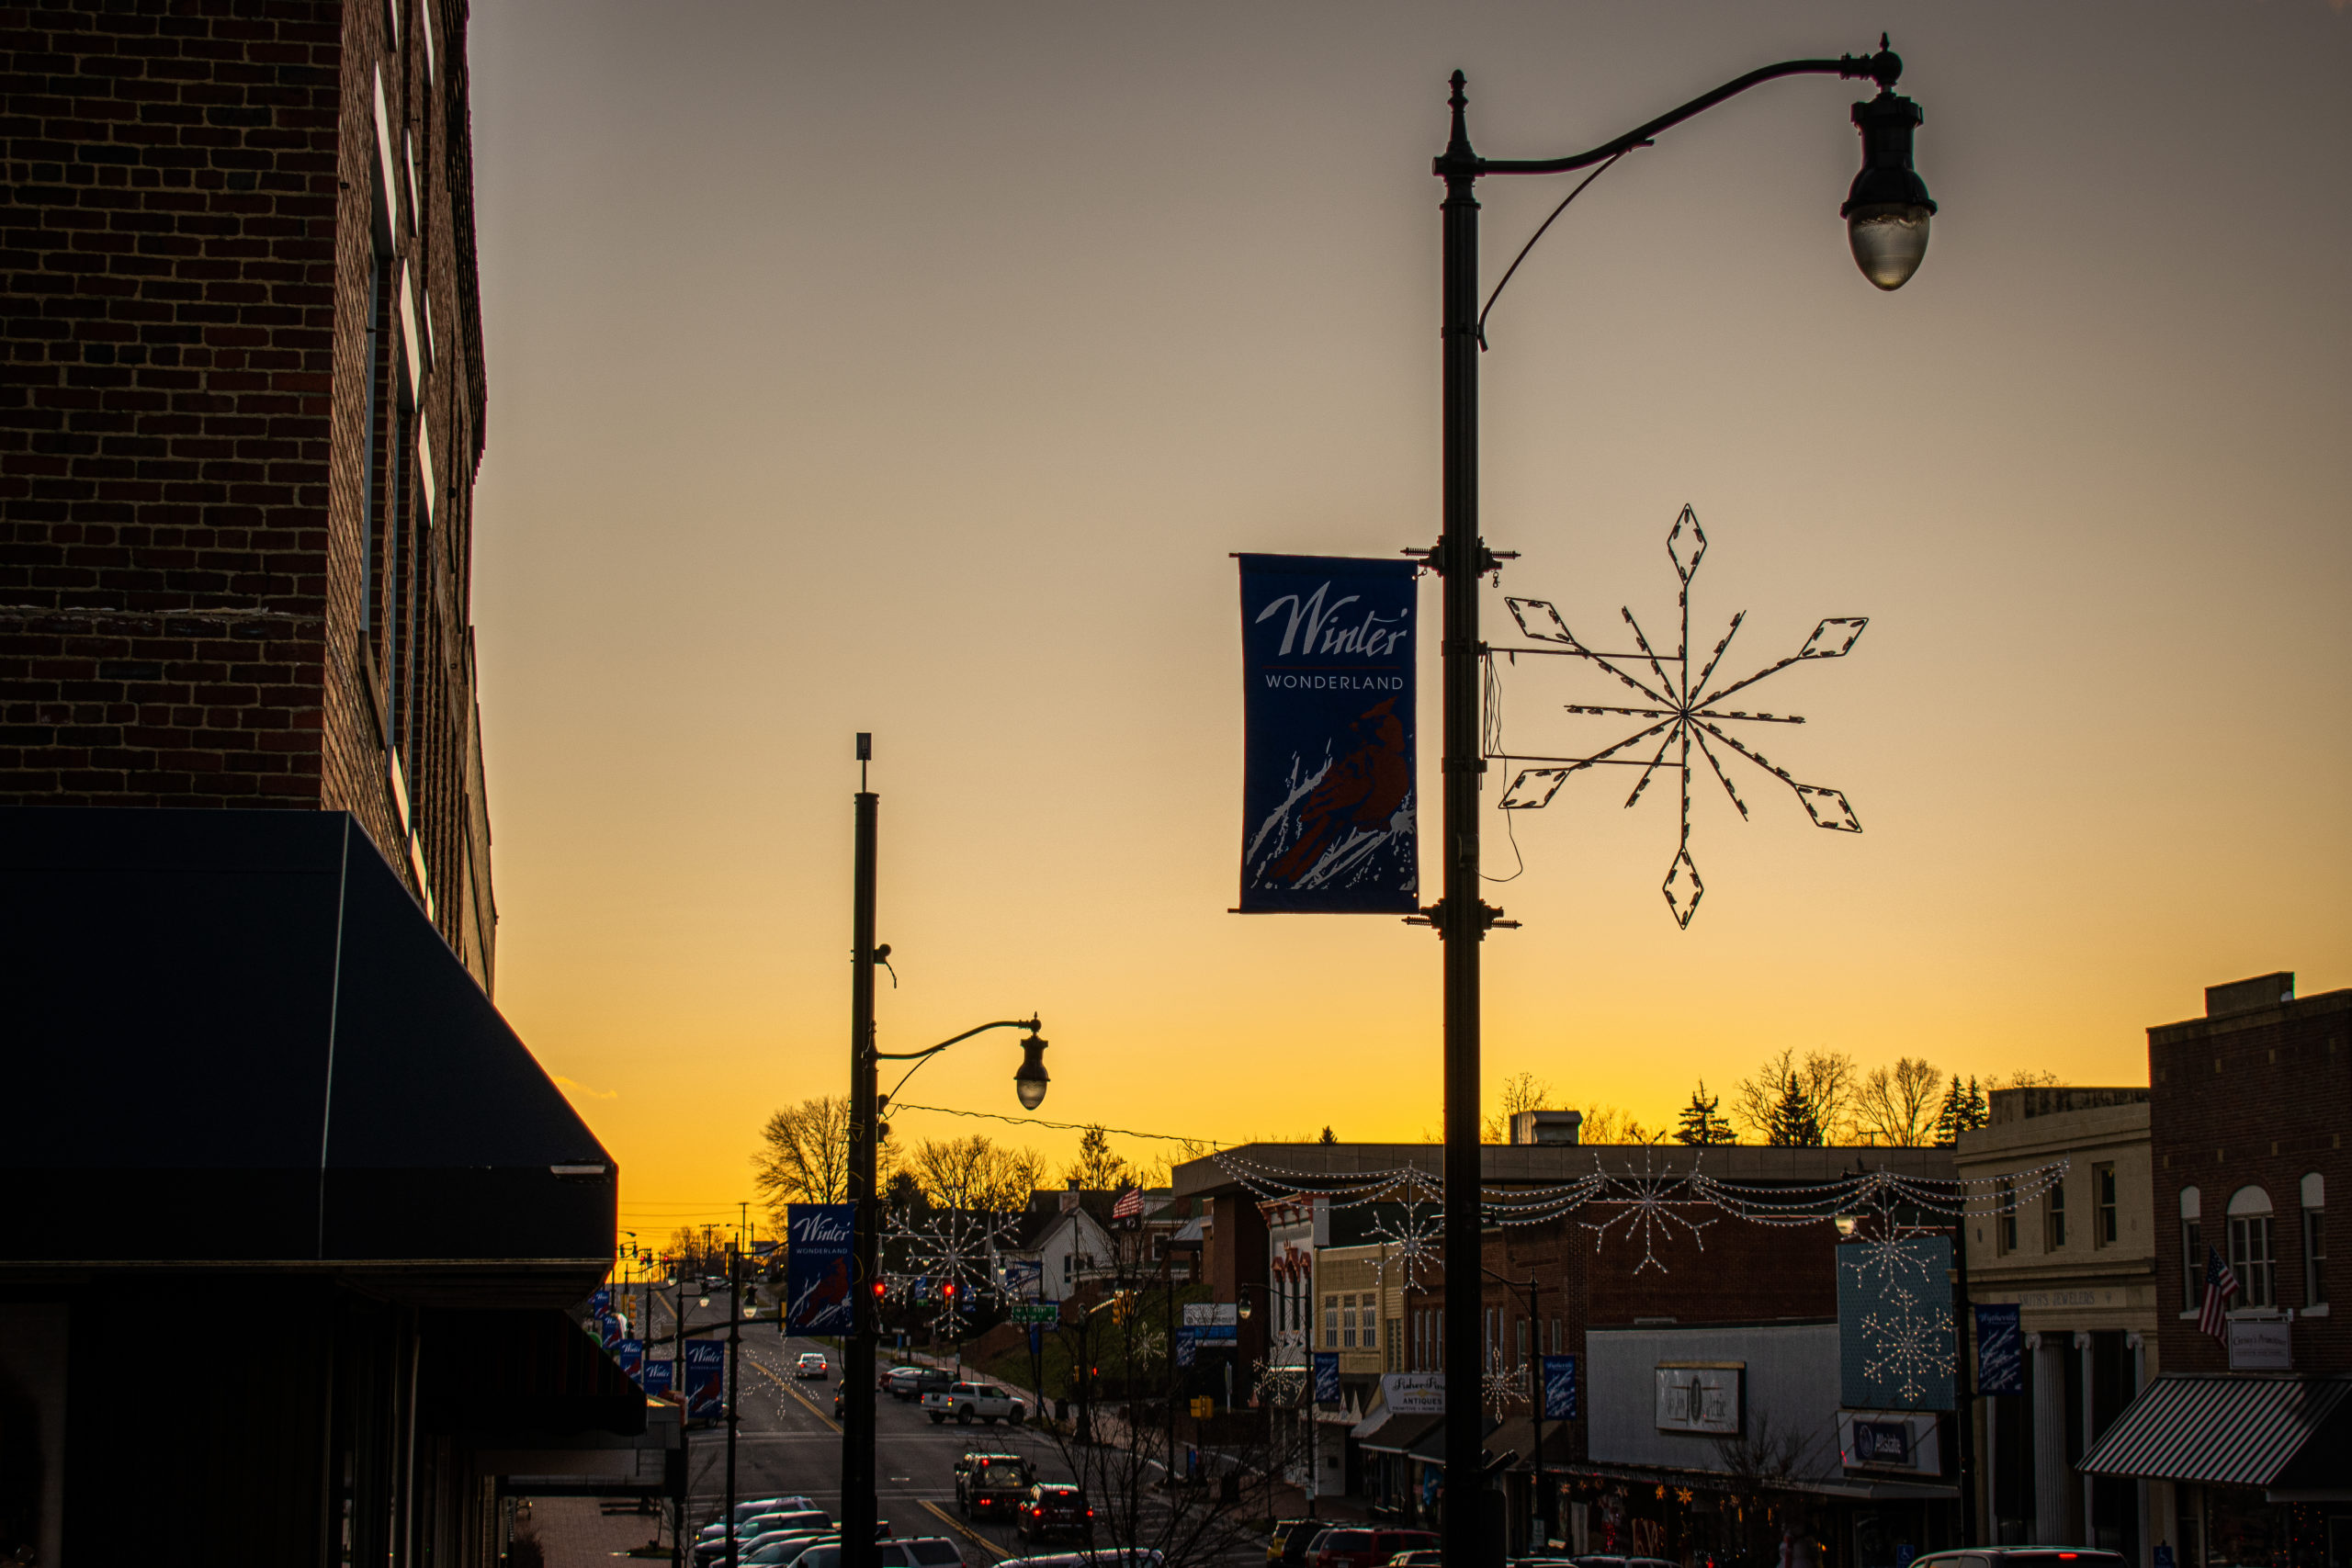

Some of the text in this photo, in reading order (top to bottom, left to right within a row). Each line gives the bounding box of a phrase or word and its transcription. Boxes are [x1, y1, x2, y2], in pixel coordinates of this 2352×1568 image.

[1255, 580, 1409, 657] Winter
[1264, 672, 1404, 691] WONDERLAND
[793, 1212, 851, 1242] Winter
[689, 1345, 722, 1363] Winter
[1875, 1433, 1902, 1455] Allstate
